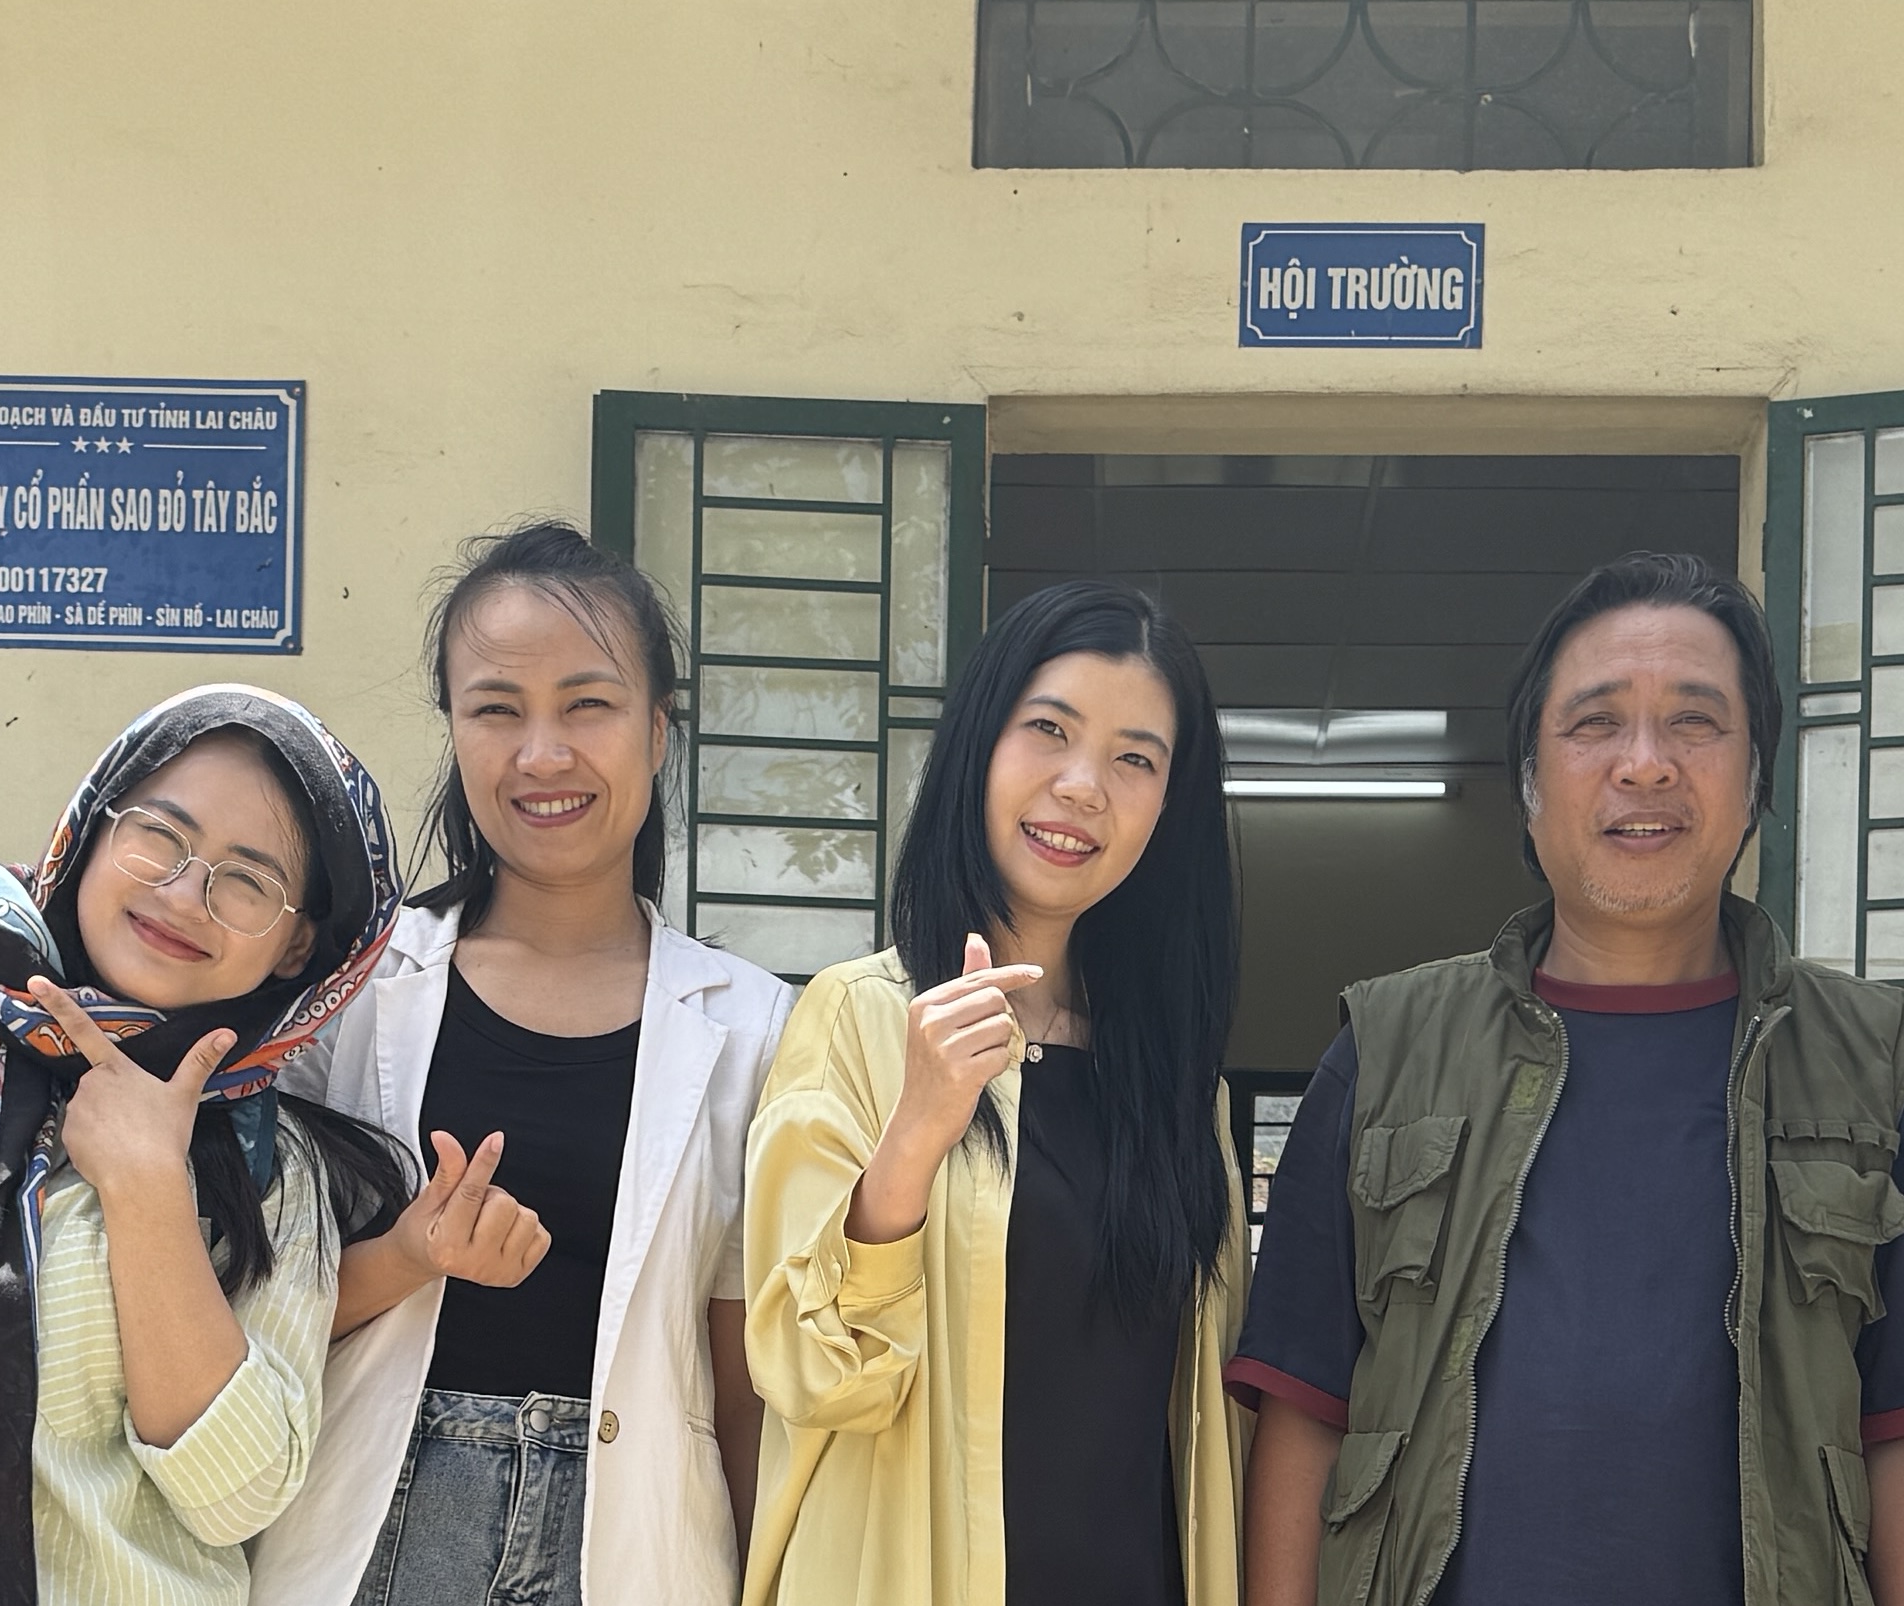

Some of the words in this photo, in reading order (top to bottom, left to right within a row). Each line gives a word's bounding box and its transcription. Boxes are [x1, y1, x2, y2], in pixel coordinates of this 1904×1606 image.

[1258, 257, 1316, 320] HỘI
[1327, 255, 1464, 310] TRƯỜNG
[51, 403, 75, 427] VÀ
[79, 401, 117, 428] ĐẦU
[121, 407, 147, 428] TƯ
[149, 401, 190, 429] TỈNH
[195, 410, 224, 430] LAI
[228, 406, 278, 431] CHÂU
[14, 468, 44, 530] CỔ
[47, 471, 105, 531] PHẦN
[110, 487, 152, 532] SAO
[157, 469, 186, 533] ĐỎ
[192, 480, 231, 533] TÂY
[236, 475, 278, 535] BẮC
[64, 601, 84, 625] SÀ
[108, 603, 143, 626] PHÌN
[155, 603, 181, 627] SÌN
[215, 608, 238, 628] LAI
[241, 605, 279, 630] CHÂU
